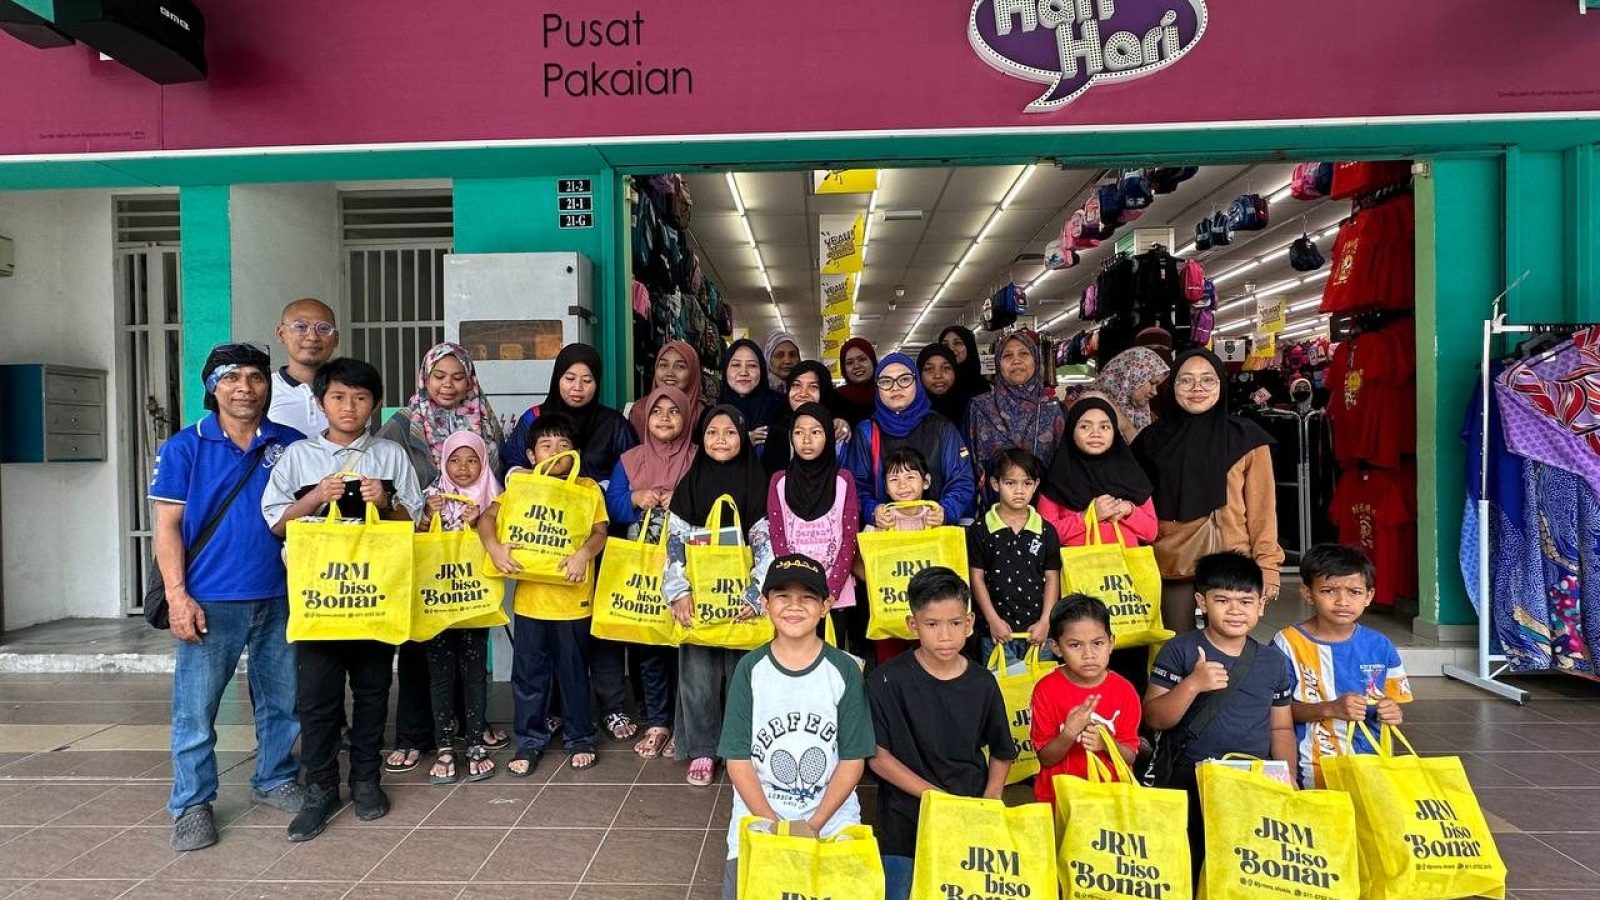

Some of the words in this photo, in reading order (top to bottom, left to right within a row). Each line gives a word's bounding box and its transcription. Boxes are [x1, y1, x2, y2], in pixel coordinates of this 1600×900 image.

[543, 10, 645, 48] Pusat
[1055, 9, 1180, 80] Hari
[543, 60, 693, 97] Pakaian
[525, 504, 564, 524] JRM
[508, 525, 572, 548] Bonar
[538, 521, 568, 536] biso
[319, 562, 370, 580] JRM
[435, 562, 473, 580] JRM
[339, 581, 377, 595] biso
[451, 579, 481, 591] biso
[637, 590, 662, 603] biso
[301, 589, 386, 610] Bonar
[420, 588, 489, 606] Bonar
[610, 592, 667, 616] Bonar
[697, 603, 740, 621] Bon
[1108, 603, 1151, 617] onar
[1414, 799, 1458, 821] JRM
[1254, 816, 1315, 849] JRM
[1439, 820, 1472, 839] biso
[1091, 828, 1148, 859] JRM
[1403, 833, 1481, 860] Bonar
[960, 846, 1020, 877] JRM
[1115, 855, 1160, 880] biso
[1280, 843, 1329, 869] biso
[1234, 847, 1340, 889] Bonar
[985, 873, 1031, 898] biso
[1070, 860, 1171, 900] Bonar
